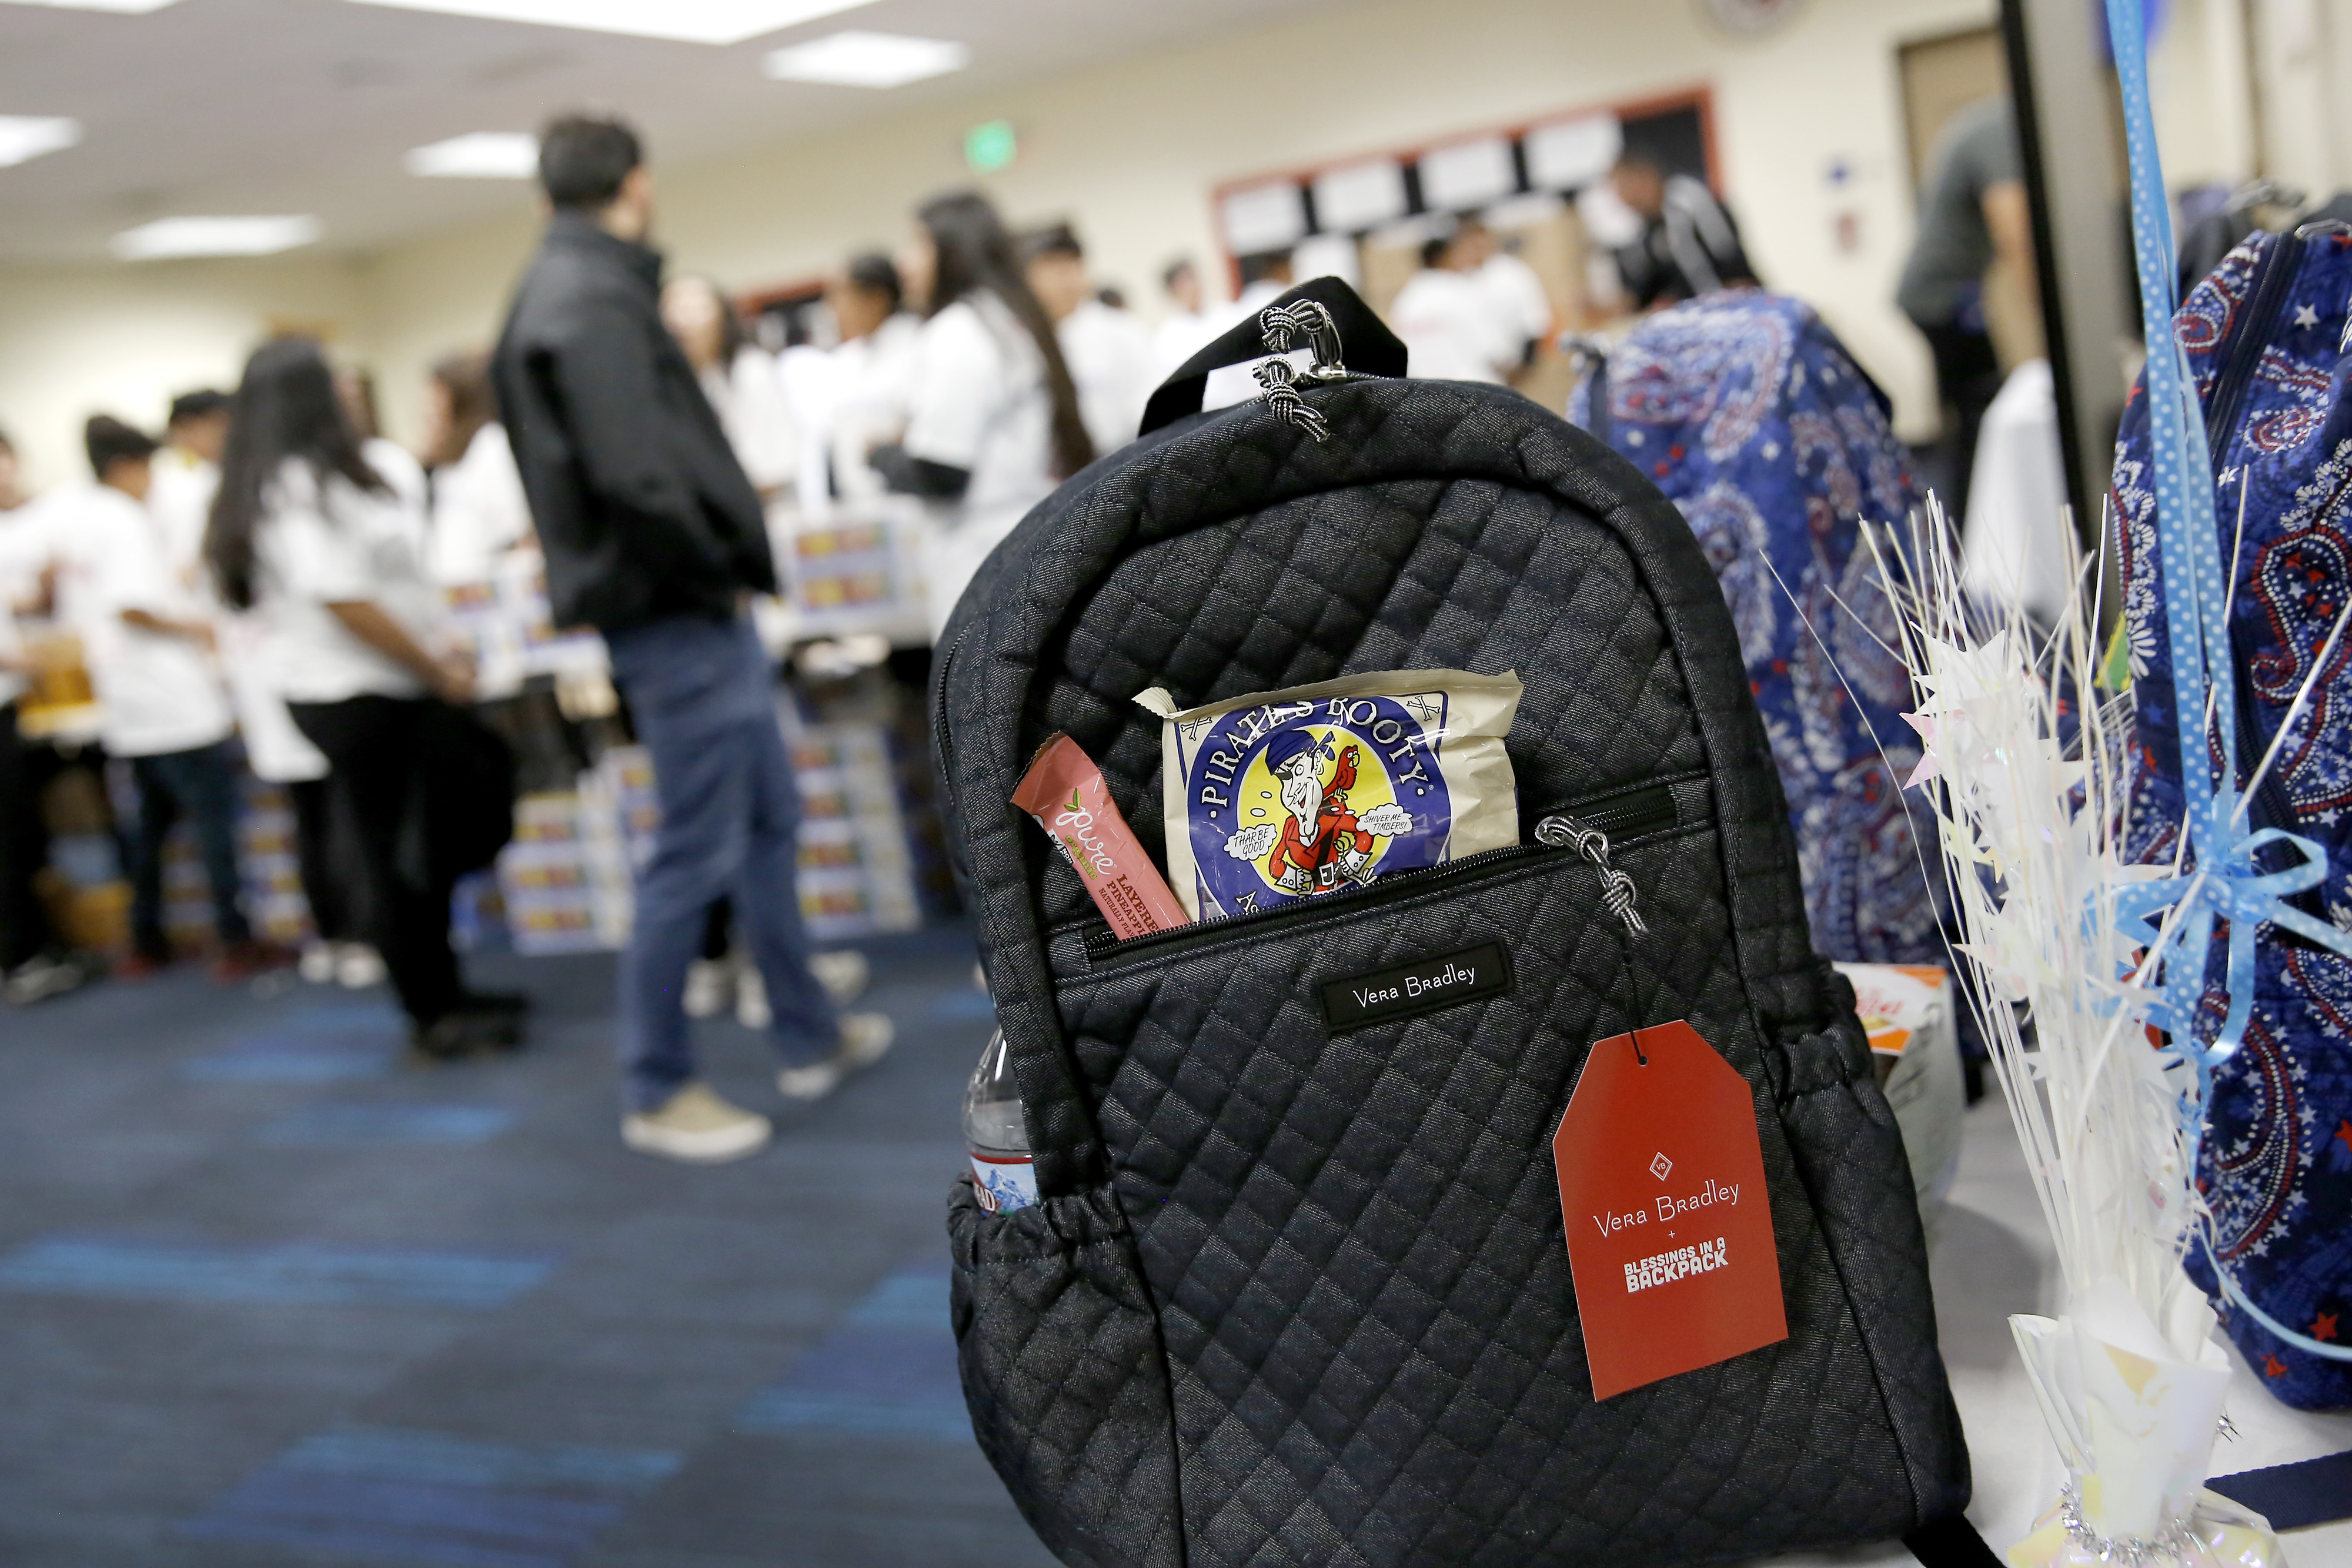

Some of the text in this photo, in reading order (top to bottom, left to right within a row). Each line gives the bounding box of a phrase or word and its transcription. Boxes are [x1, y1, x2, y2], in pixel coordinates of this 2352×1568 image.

[1327, 697, 1428, 784] BOOTY
[1234, 827, 1269, 847] THAR BE
[1364, 813, 1403, 823] SHIVER ME
[1373, 821, 1408, 831] TIMBERS!
[1055, 806, 1114, 875] pure
[1065, 835, 1097, 880] organic
[1242, 840, 1265, 857] GOOD
[1098, 888, 1124, 922] NATURALLY
[1116, 874, 1160, 933] LAYERE
[1352, 964, 1475, 1008] Vera Bradley
[1656, 1162, 1666, 1170] VB
[1592, 1179, 1739, 1237] Vera Bradley
[1623, 1236, 1726, 1276] BLESSINGS IN A
[1625, 1249, 1728, 1293] BACKPACK
